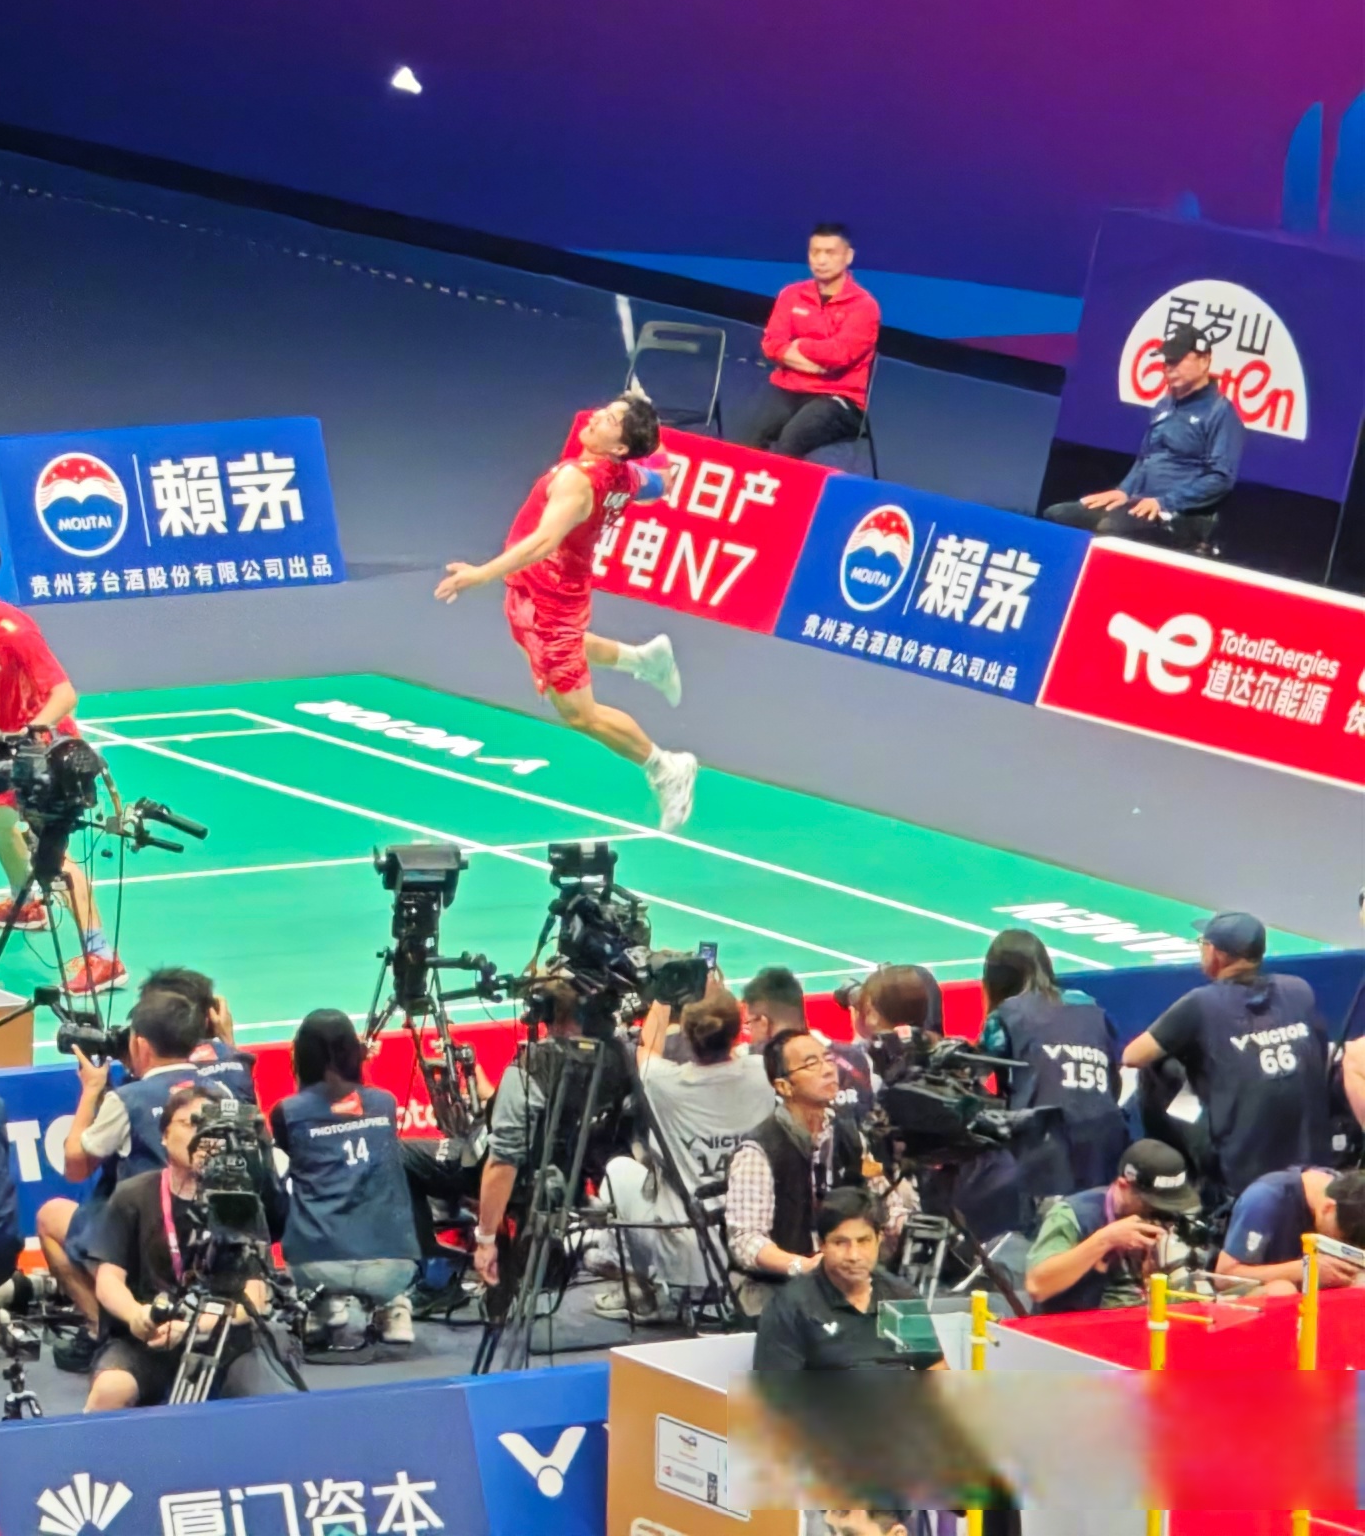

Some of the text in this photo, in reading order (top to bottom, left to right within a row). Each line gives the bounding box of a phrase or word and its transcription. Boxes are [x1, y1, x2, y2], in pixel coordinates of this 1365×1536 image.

[57, 515, 113, 533] MOUTAI
[29, 554, 334, 599] 贵州茅台酒股份有限公司出品
[1219, 627, 1341, 681] TotalEnergies
[1200, 658, 1333, 726] 道达尔能源
[1249, 1022, 1310, 1046] VICTOR
[1259, 1044, 1297, 1076] 66
[1061, 1060, 1108, 1094] 159
[310, 1116, 390, 1138] PHOTOGRAPHER
[343, 1136, 370, 1166] 14
